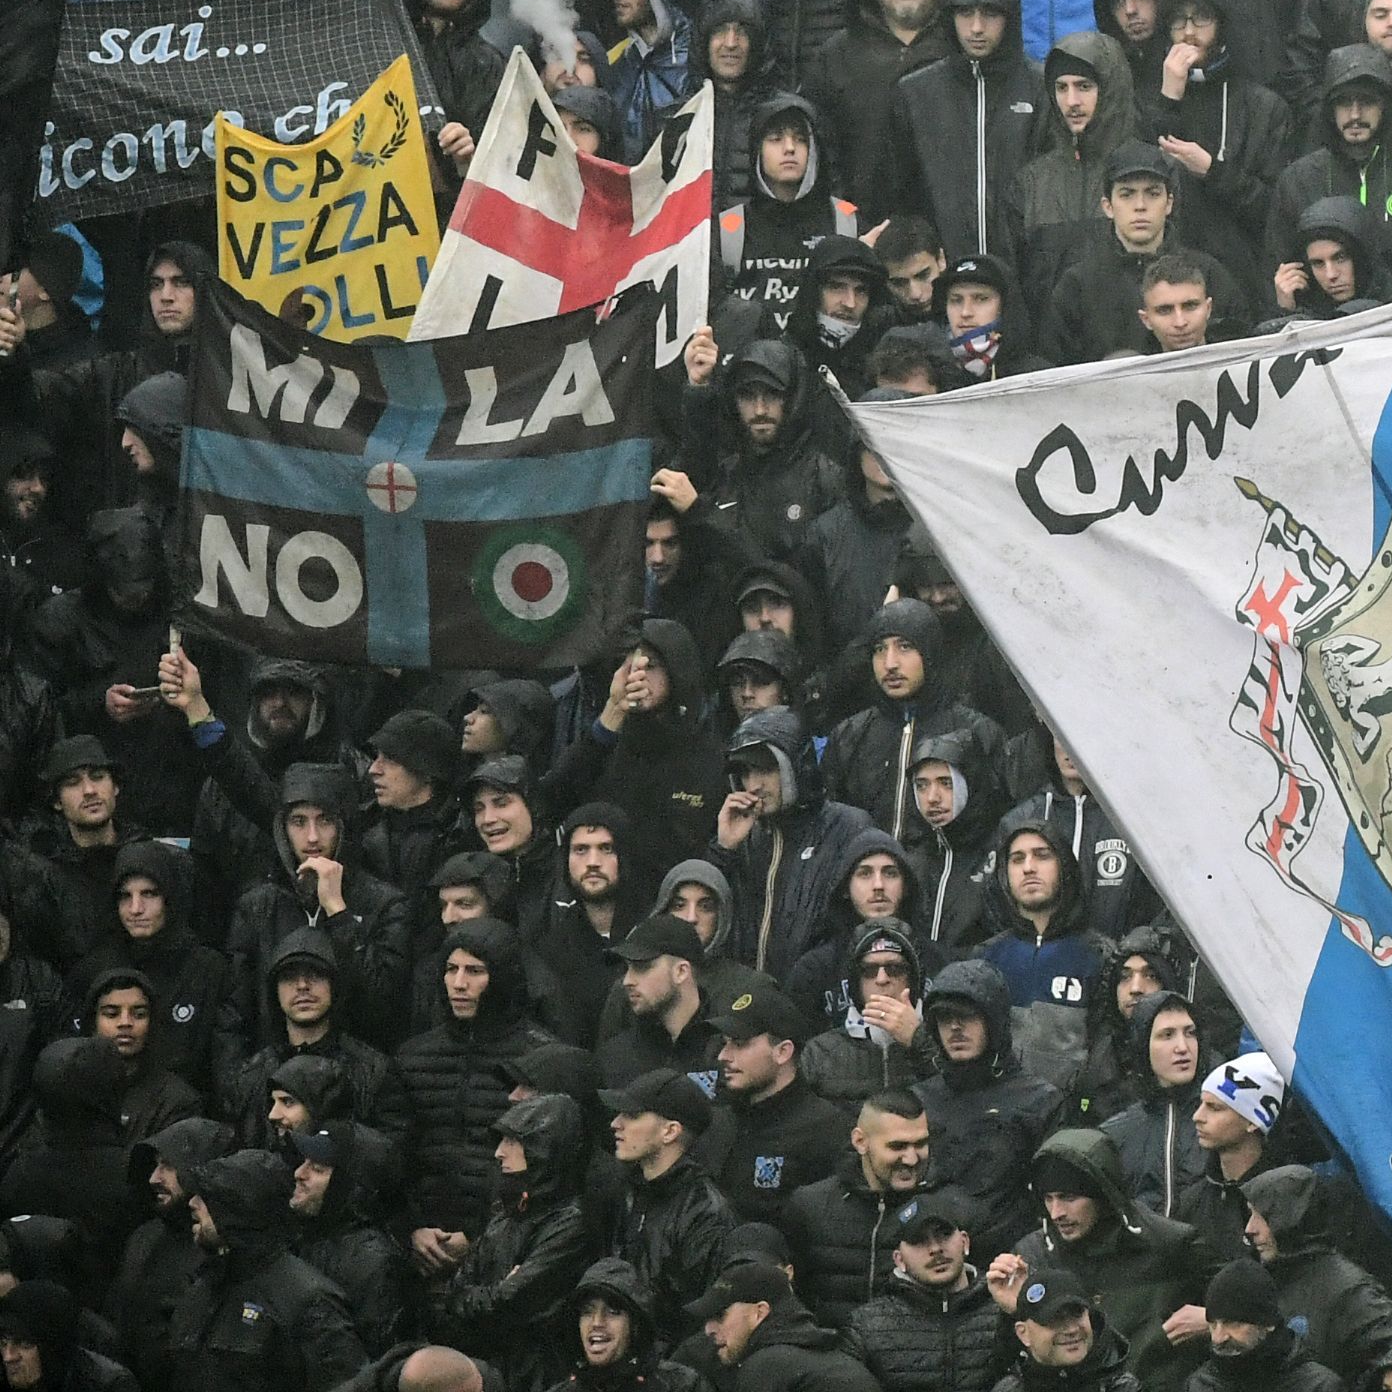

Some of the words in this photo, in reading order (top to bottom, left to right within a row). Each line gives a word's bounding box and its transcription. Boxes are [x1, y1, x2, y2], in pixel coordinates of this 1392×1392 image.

[225, 179, 420, 281] VEZZA
[455, 339, 614, 446] LA
[193, 515, 363, 628] NO
